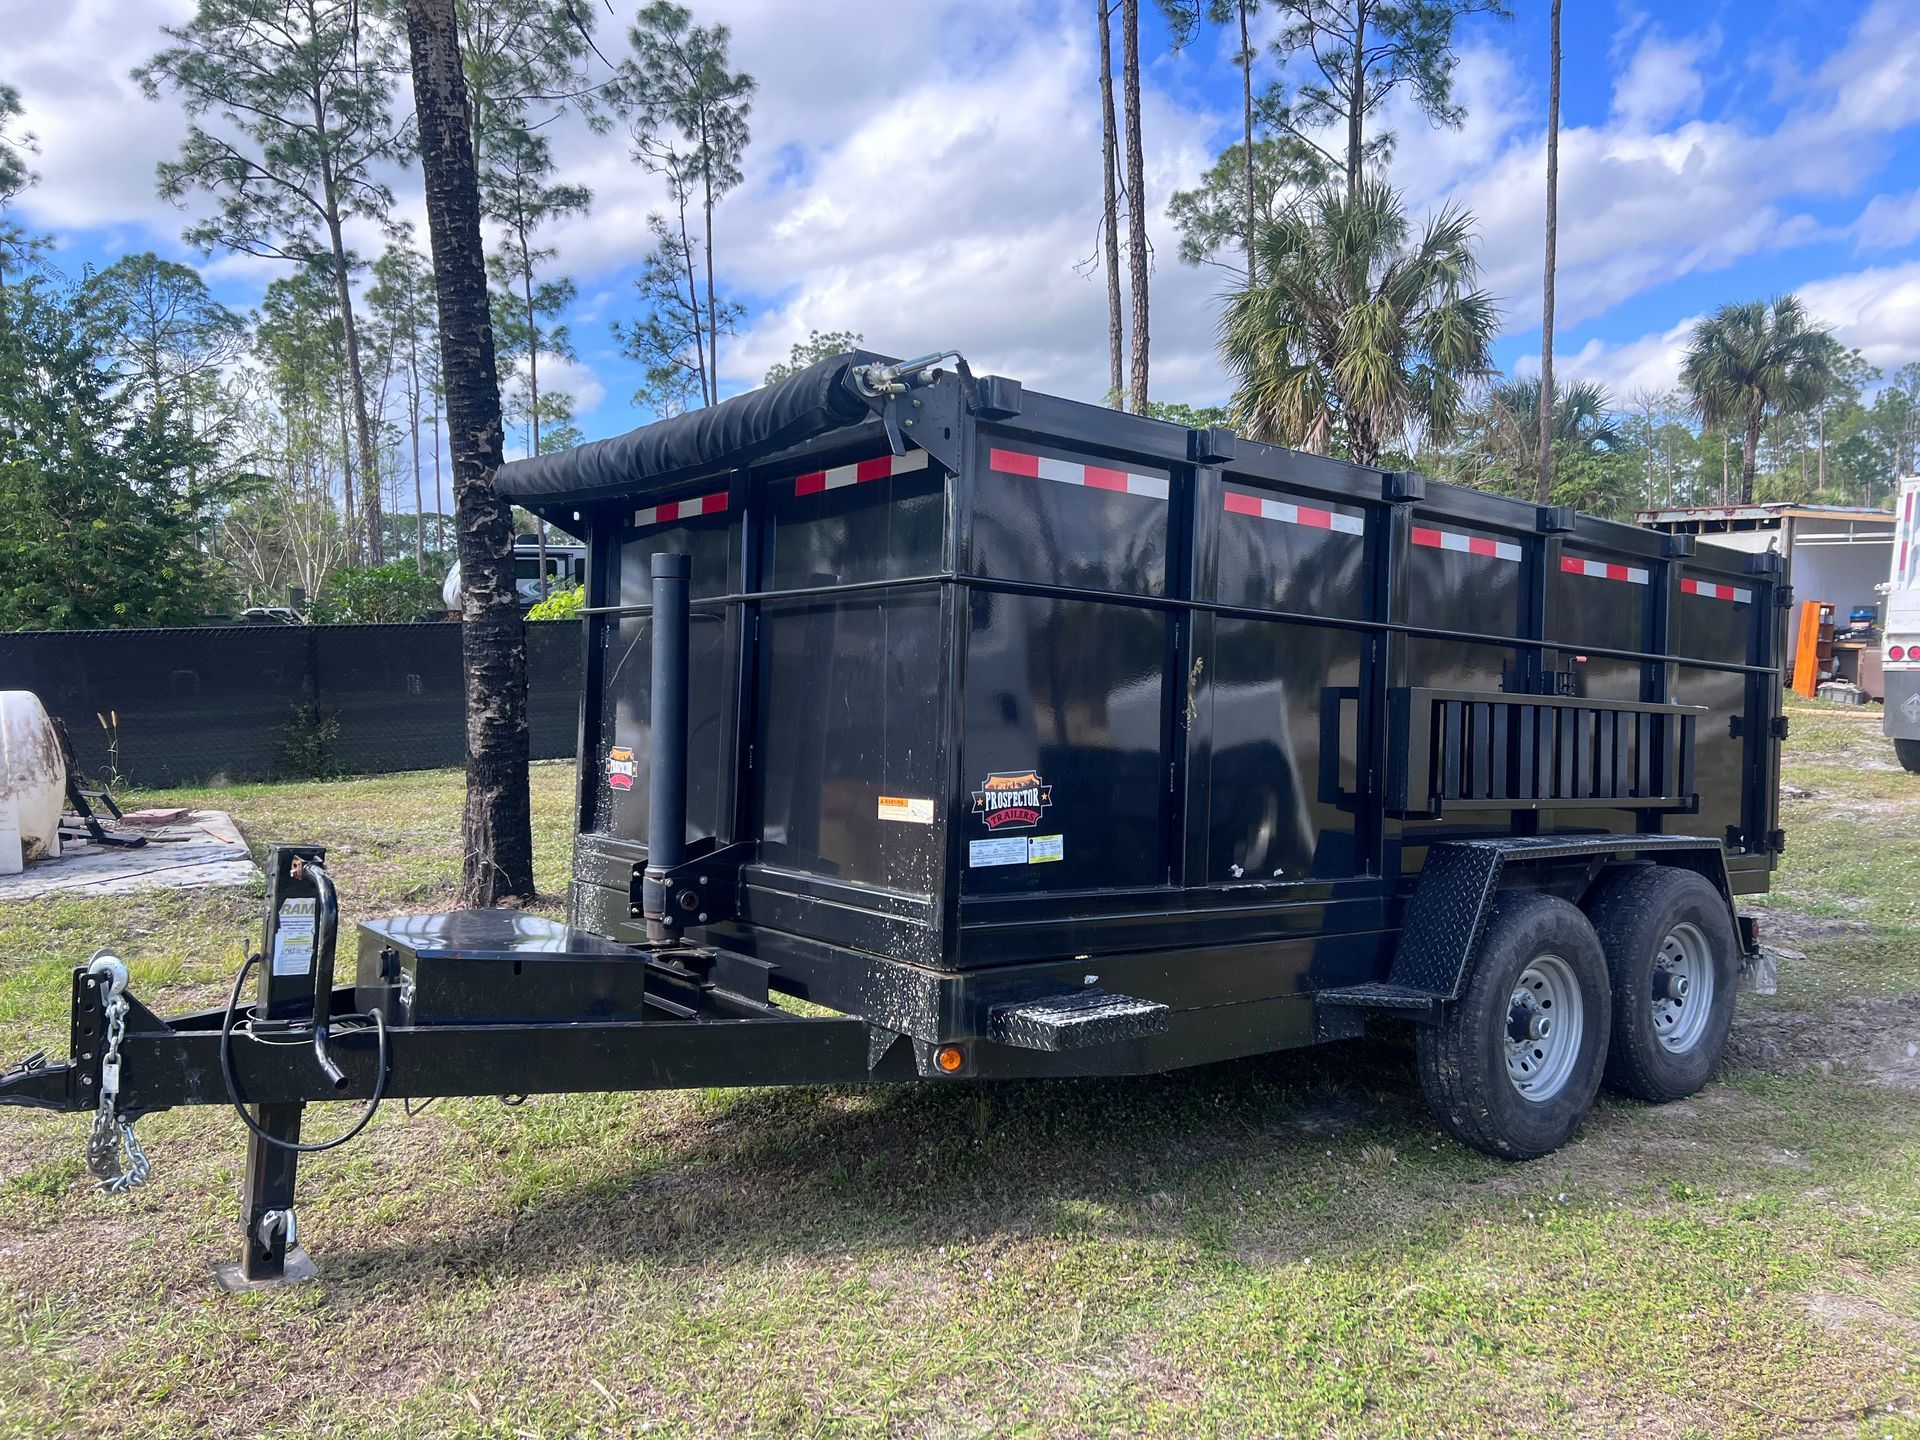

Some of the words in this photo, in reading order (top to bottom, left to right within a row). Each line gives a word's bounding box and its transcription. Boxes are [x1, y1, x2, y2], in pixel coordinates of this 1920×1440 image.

[985, 788, 1040, 811] PROSPECTOR
[990, 811, 1035, 825] TRAILERS
[280, 903, 315, 915] RAM
